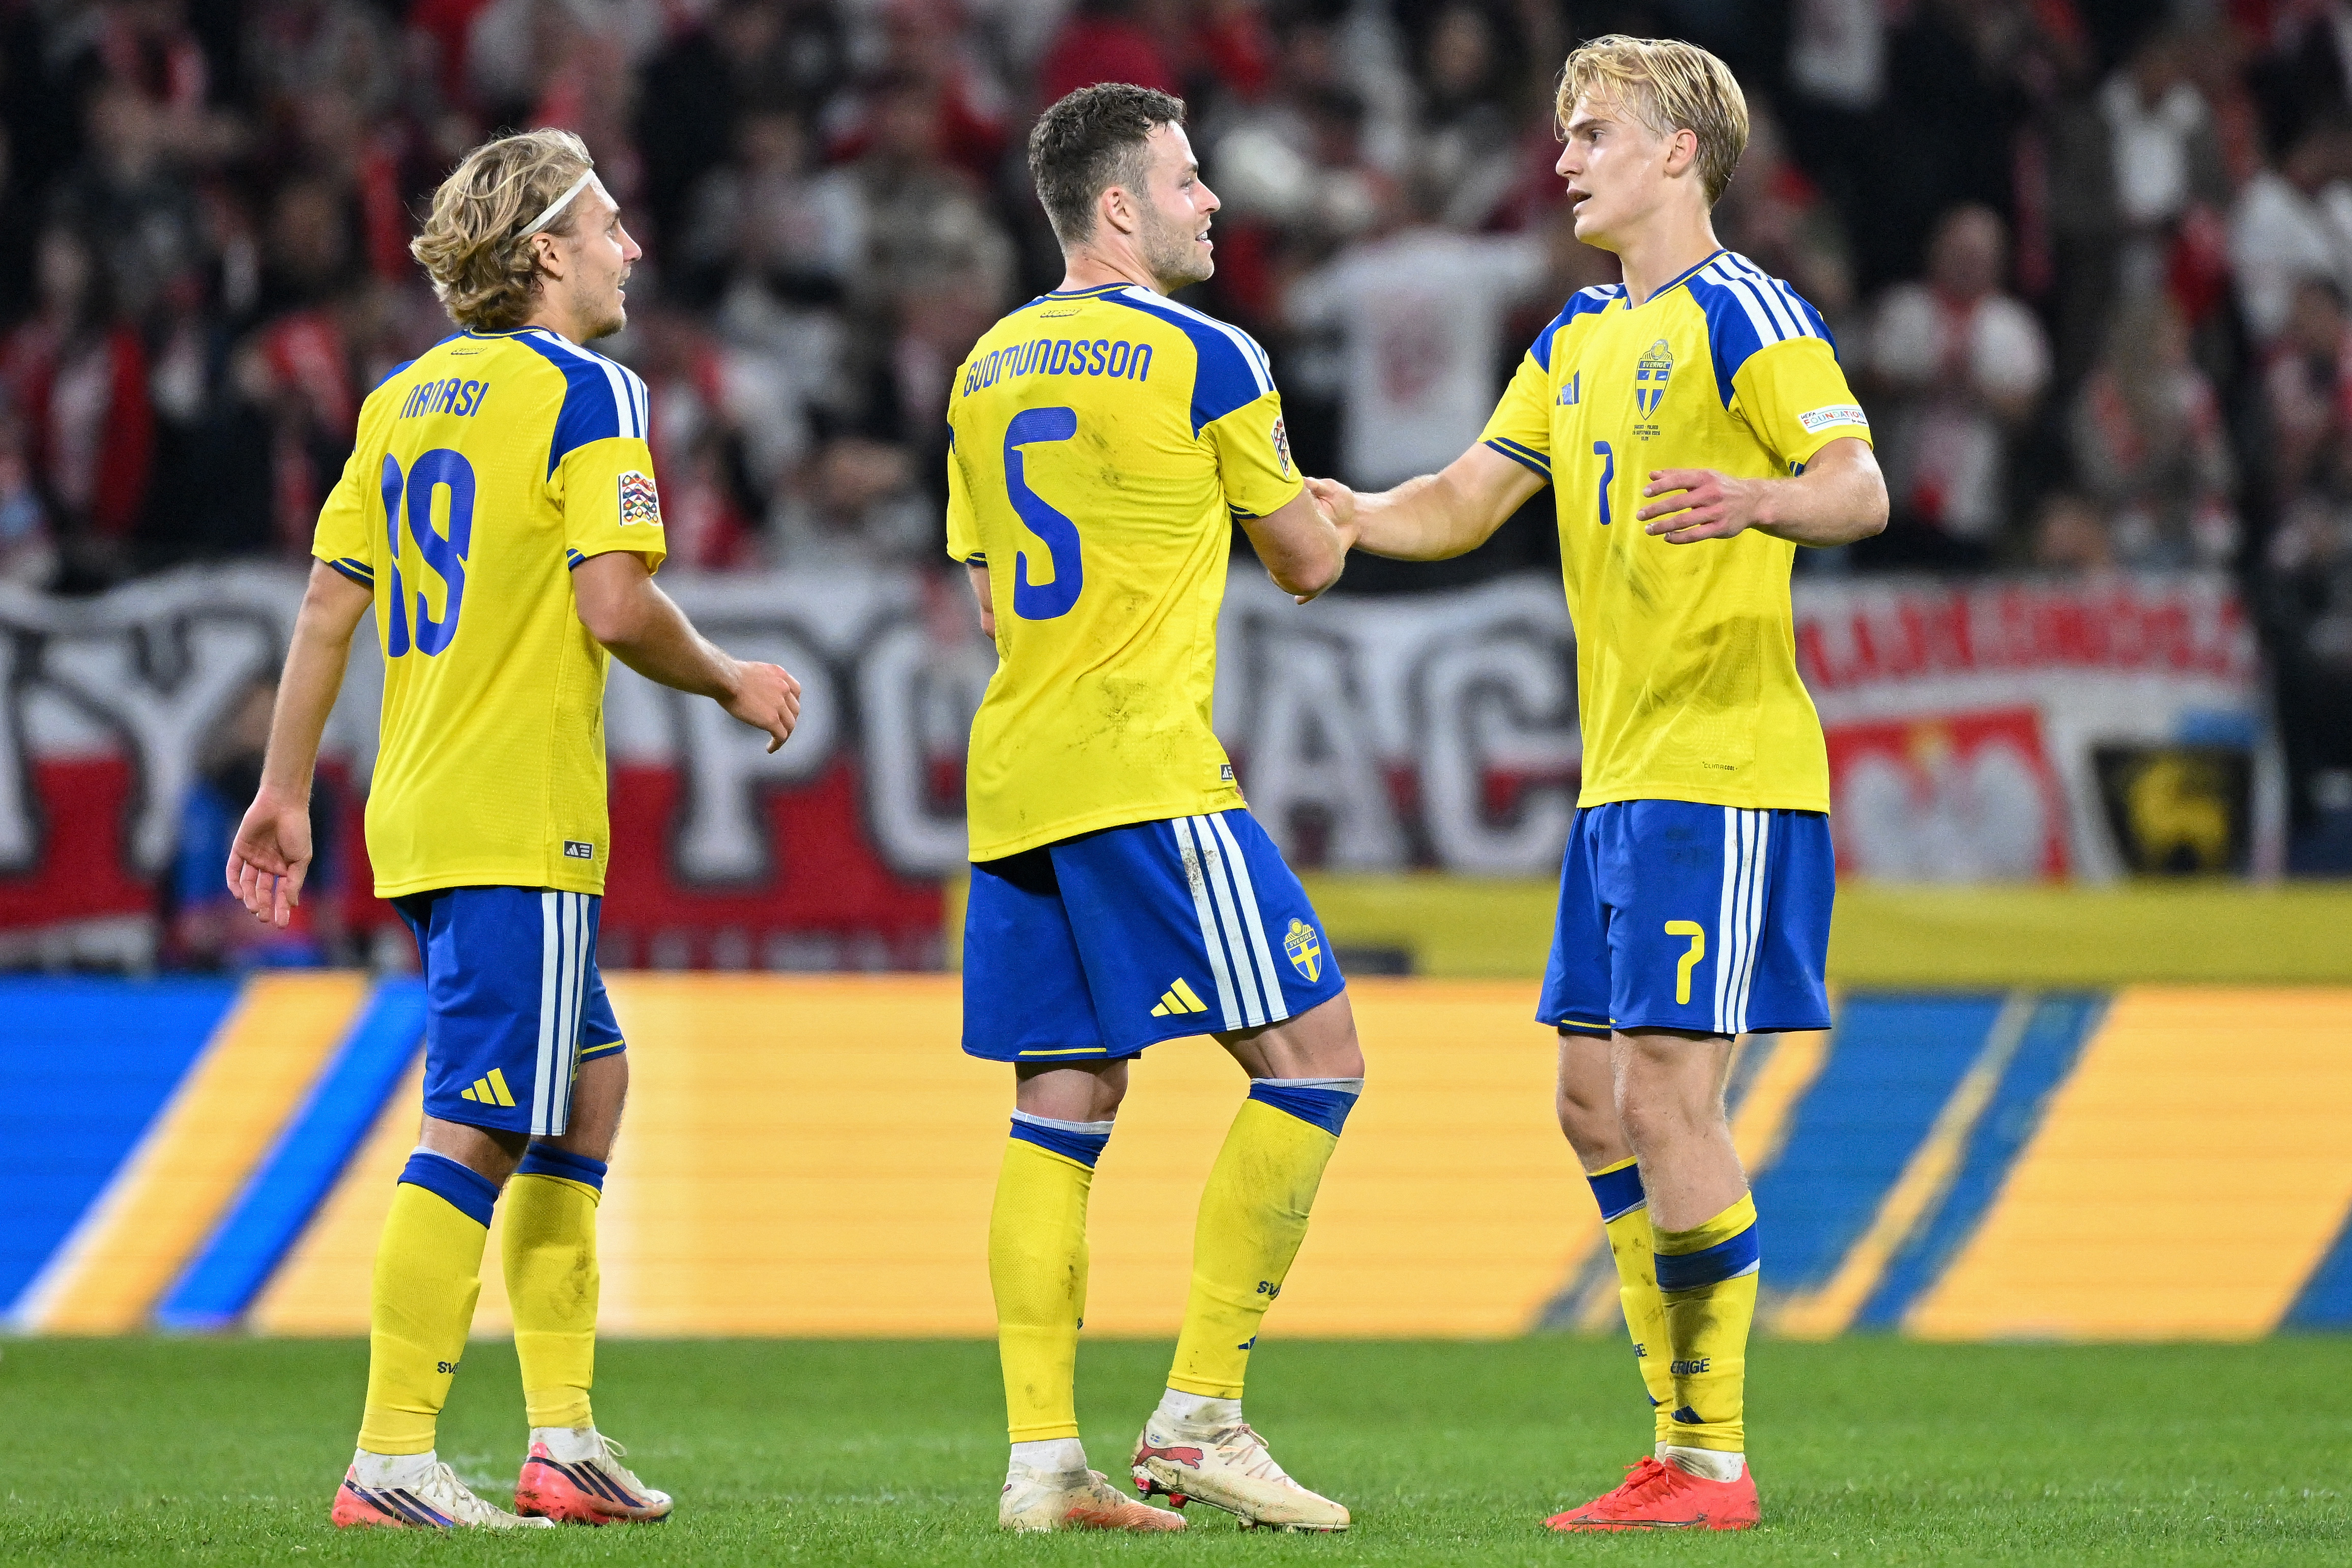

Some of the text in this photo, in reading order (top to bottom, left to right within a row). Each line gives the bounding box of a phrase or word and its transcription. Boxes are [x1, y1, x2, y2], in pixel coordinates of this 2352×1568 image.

[399, 378, 489, 419] NANASI
[963, 339, 1153, 397] GUDMUNDSSON
[1804, 411, 1865, 426] FOUNDATION
[1003, 406, 1083, 620] 5
[1593, 441, 1614, 526] 7
[381, 448, 476, 657] 19
[1289, 932, 1312, 947] SVERIGE
[1665, 920, 1704, 1004] 7
